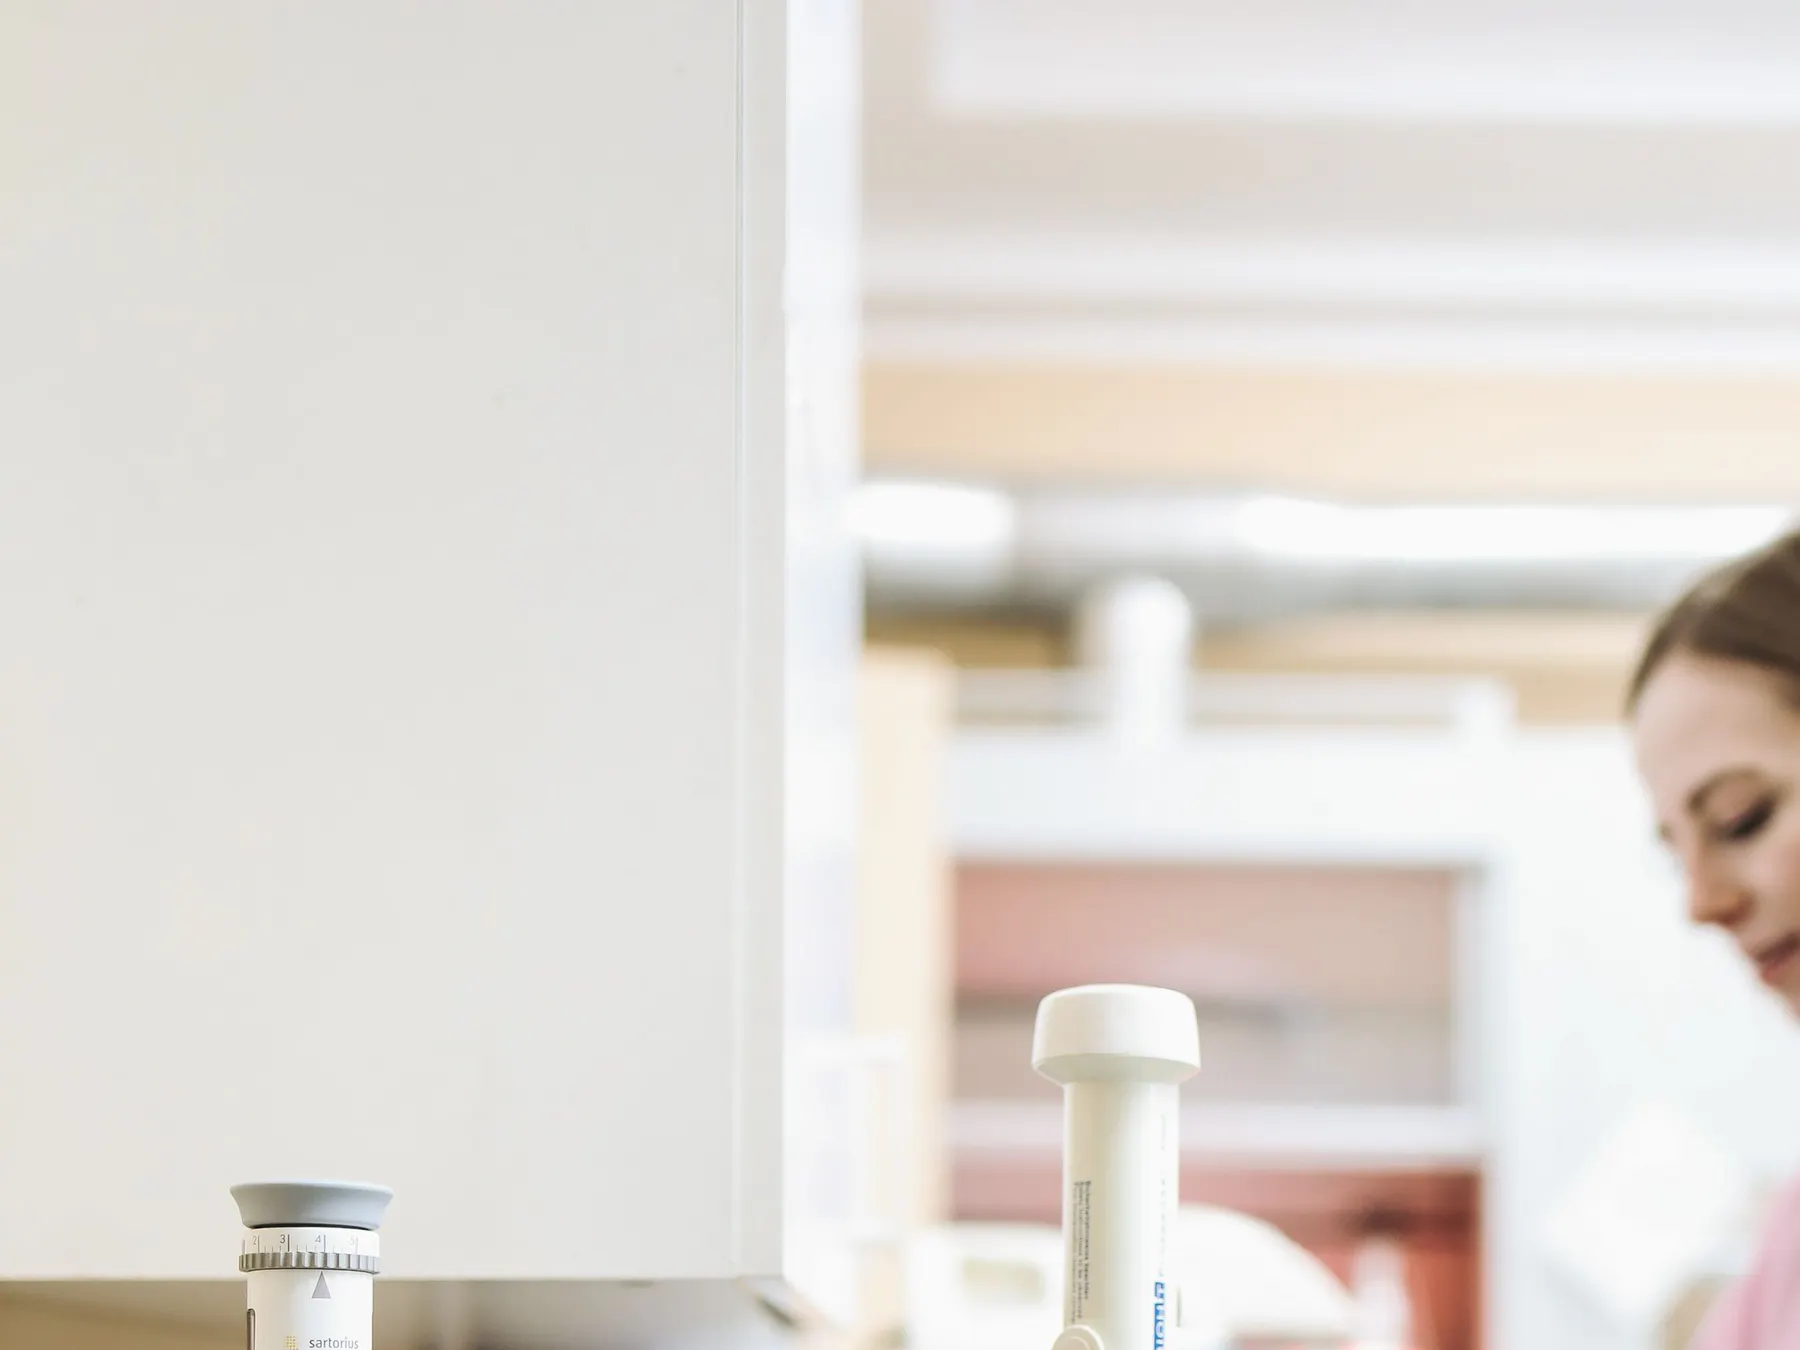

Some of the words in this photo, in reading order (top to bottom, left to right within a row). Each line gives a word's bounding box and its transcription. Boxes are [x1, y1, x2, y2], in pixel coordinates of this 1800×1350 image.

[280, 1234, 286, 1244] 3
[315, 1234, 321, 1243] 4
[309, 1336, 359, 1349] sartorius
